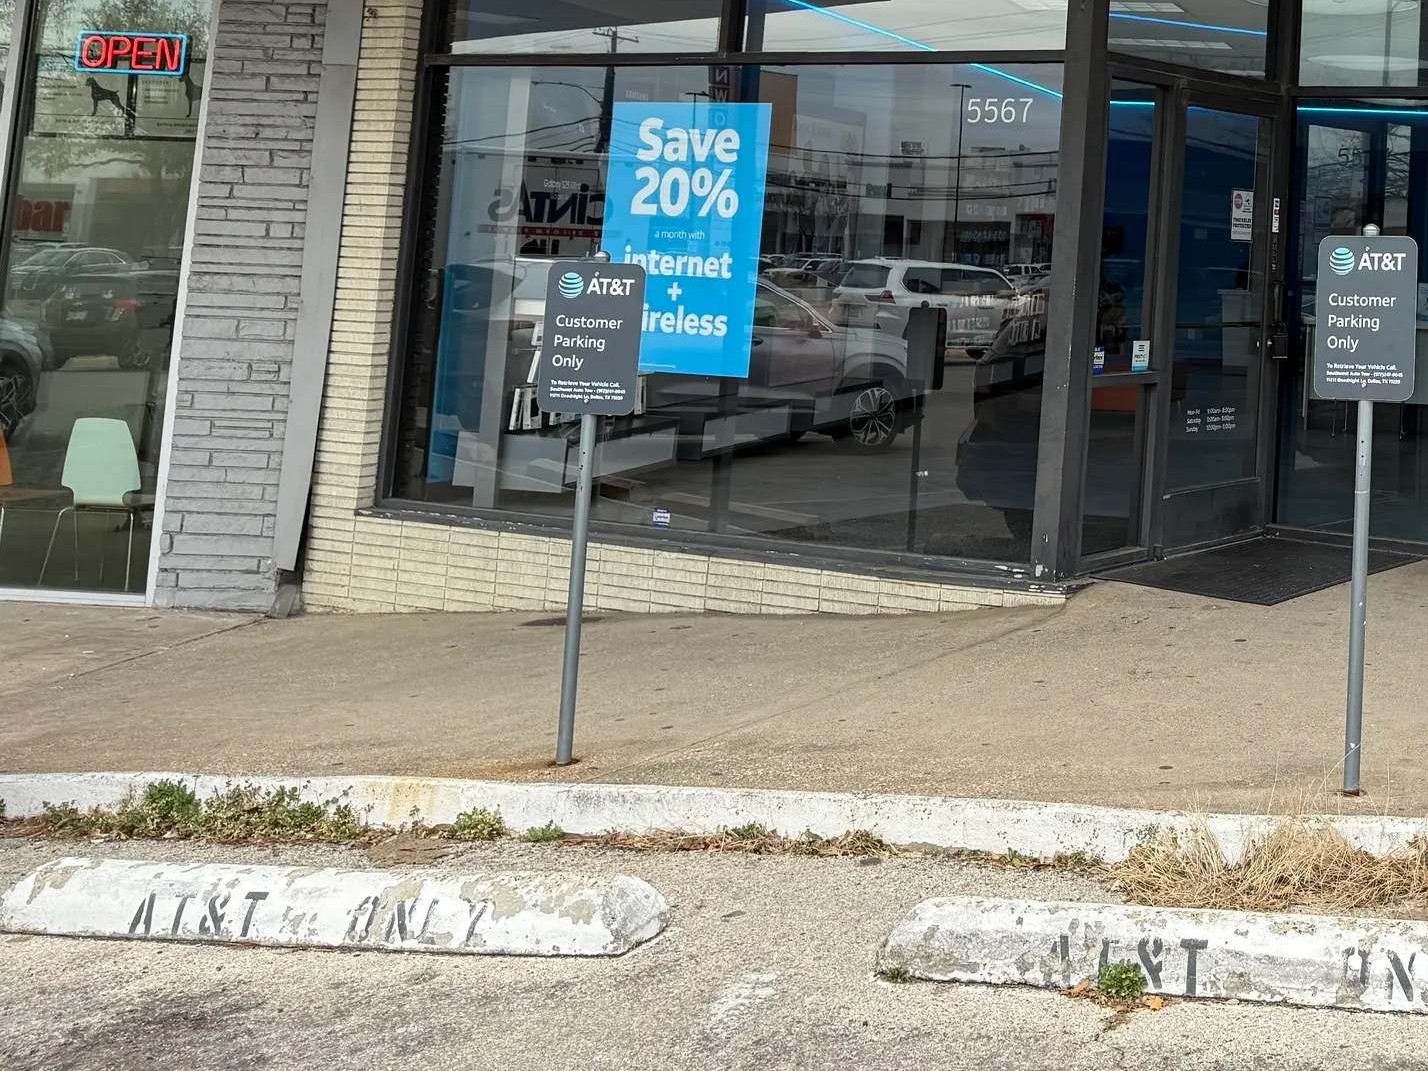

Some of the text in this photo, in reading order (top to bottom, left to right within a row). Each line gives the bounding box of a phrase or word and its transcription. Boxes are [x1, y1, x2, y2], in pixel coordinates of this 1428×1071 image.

[82, 35, 182, 71] OPEN
[967, 98, 1034, 123] 5567
[636, 117, 740, 163] Save
[630, 166, 739, 218] 20%
[661, 230, 687, 240] month
[688, 230, 705, 240] with
[623, 245, 732, 279] internet
[1358, 253, 1406, 272] AT&T
[586, 278, 635, 296] AT&T
[1328, 293, 1397, 307] Customer
[556, 314, 623, 330] Customer
[642, 304, 728, 337] ireless
[1328, 314, 1380, 331] Parking
[554, 334, 606, 352] Parking
[1327, 335, 1359, 352] Only
[552, 354, 584, 371] Only
[128, 890, 270, 937] AT&T
